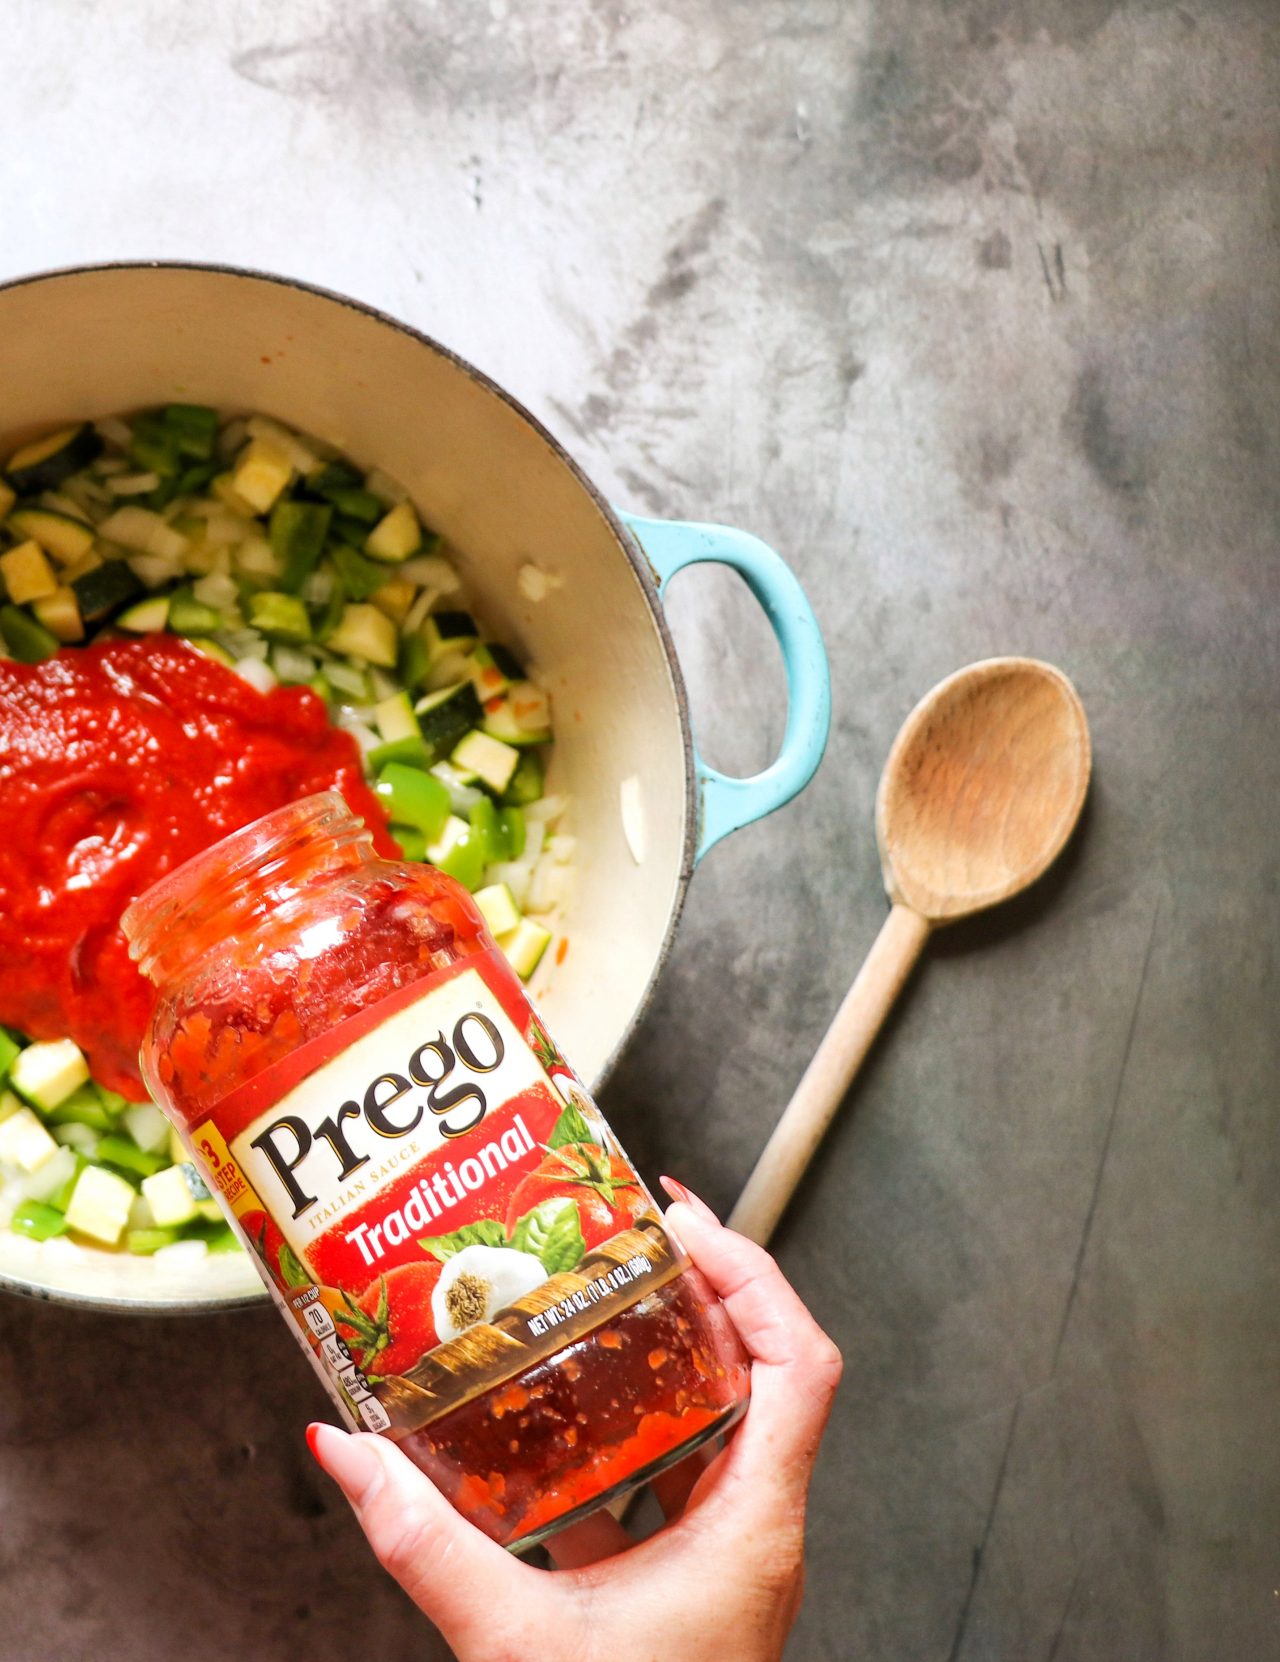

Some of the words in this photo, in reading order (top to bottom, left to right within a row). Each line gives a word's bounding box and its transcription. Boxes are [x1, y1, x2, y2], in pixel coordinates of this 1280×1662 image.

[250, 1011, 505, 1220] Prego
[201, 1139, 220, 1168] 3
[215, 1162, 235, 1189] STEP
[308, 1181, 366, 1229] ITALIAN
[370, 1141, 421, 1182] SAUCE
[346, 1113, 538, 1266] Traditional
[308, 1286, 320, 1300] CUP
[527, 1314, 549, 1337] NET
[544, 1305, 566, 1326] WT.
[560, 1298, 577, 1317] 24
[572, 1290, 591, 1311] OZ.
[595, 1278, 613, 1297] LB.
[607, 1272, 618, 1288] 8
[309, 1308, 324, 1326] 70
